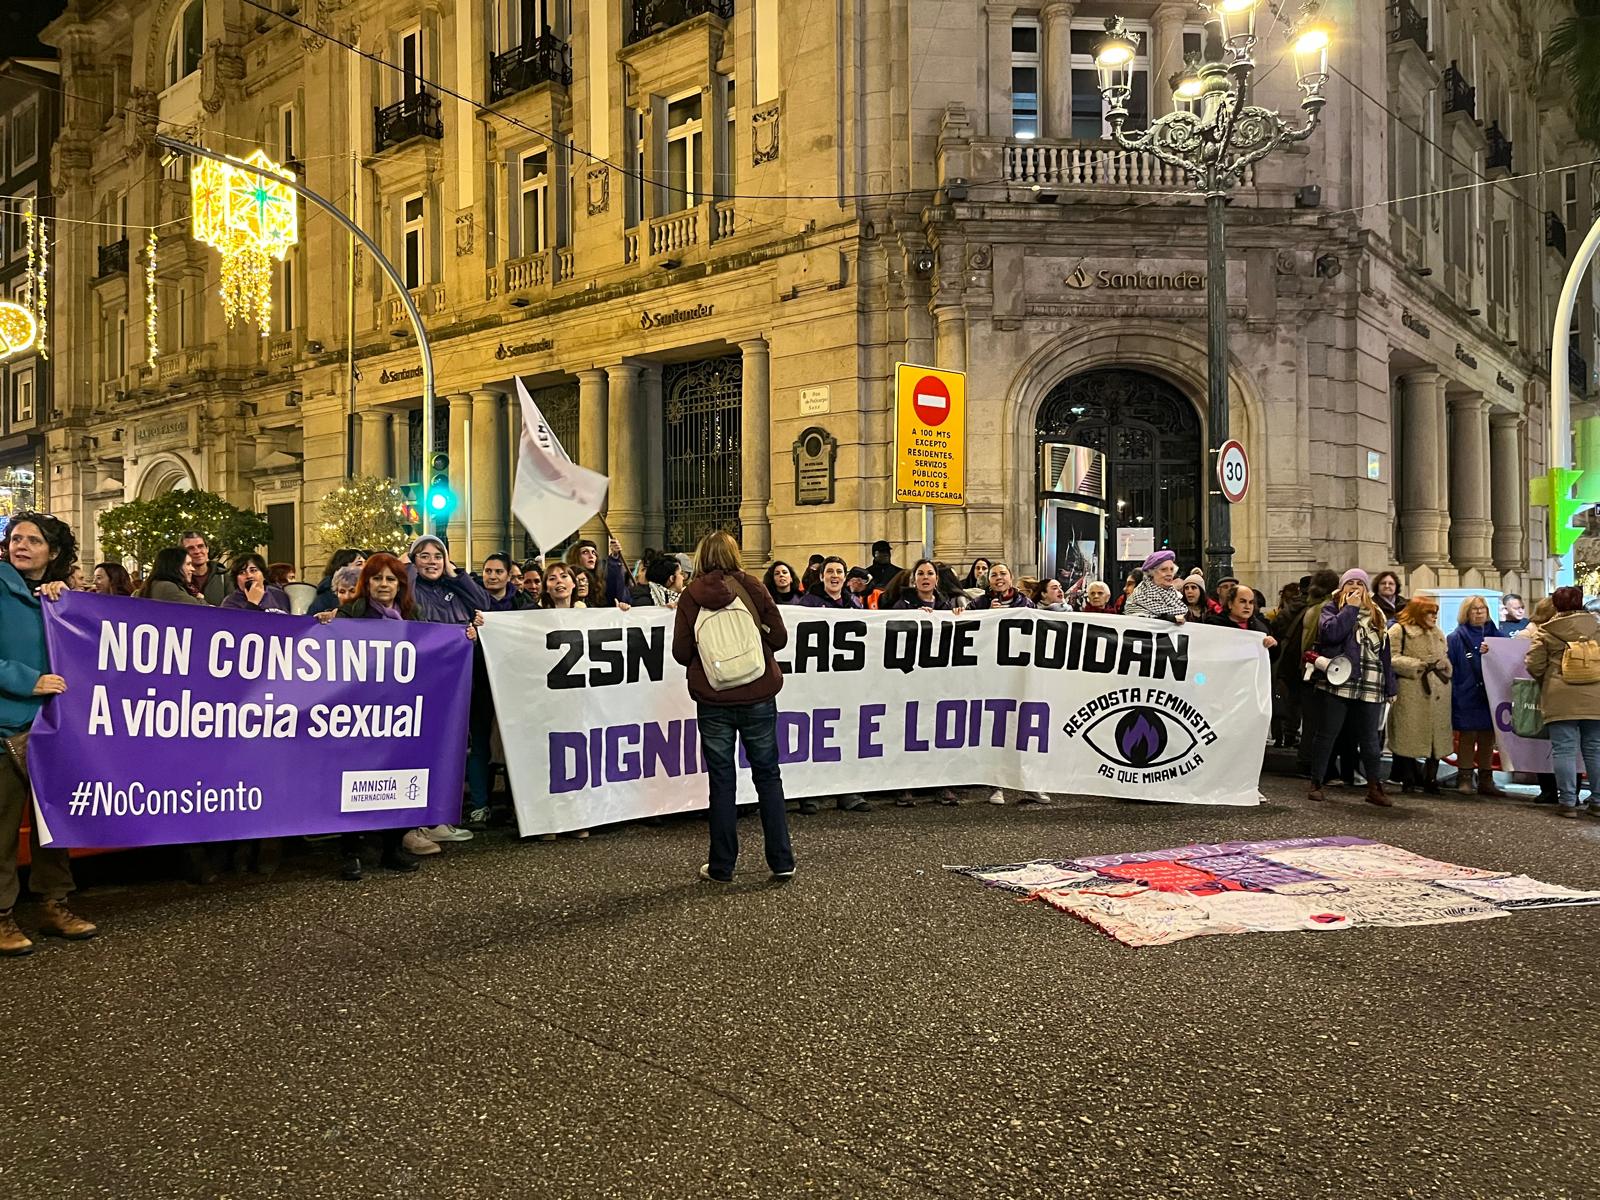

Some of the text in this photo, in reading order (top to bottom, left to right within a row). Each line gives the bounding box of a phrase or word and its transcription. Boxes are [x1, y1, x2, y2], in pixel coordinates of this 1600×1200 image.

[1097, 269, 1207, 290] Santander
[653, 303, 715, 328] Santander
[506, 337, 554, 358] Santander
[915, 439, 947, 448] EXCEPTO
[921, 429, 933, 437] 100
[936, 431, 951, 439] MTS
[915, 460, 947, 469] SERVIZOS
[1226, 461, 1243, 481] 30
[897, 488, 962, 500] CARGA/DESCARGA
[914, 480, 939, 488] MOTOS
[98, 620, 417, 684] NON CONSINTO
[546, 626, 665, 689] 25N
[884, 620, 981, 674] QUE
[997, 618, 1189, 681] COIDAN
[88, 684, 423, 738] A violencia sexual
[1062, 688, 1218, 746] RESPOSTA FEMINISTA
[549, 699, 1050, 794] DIGNIDE E LOITA
[1098, 763, 1115, 779] AS
[1117, 770, 1139, 783] QUE
[1142, 767, 1178, 783] MIRAN
[351, 777, 397, 793] AMNISTÍA
[68, 781, 262, 816] #NoConsiento
[351, 793, 397, 802] INTERNACIONAL
